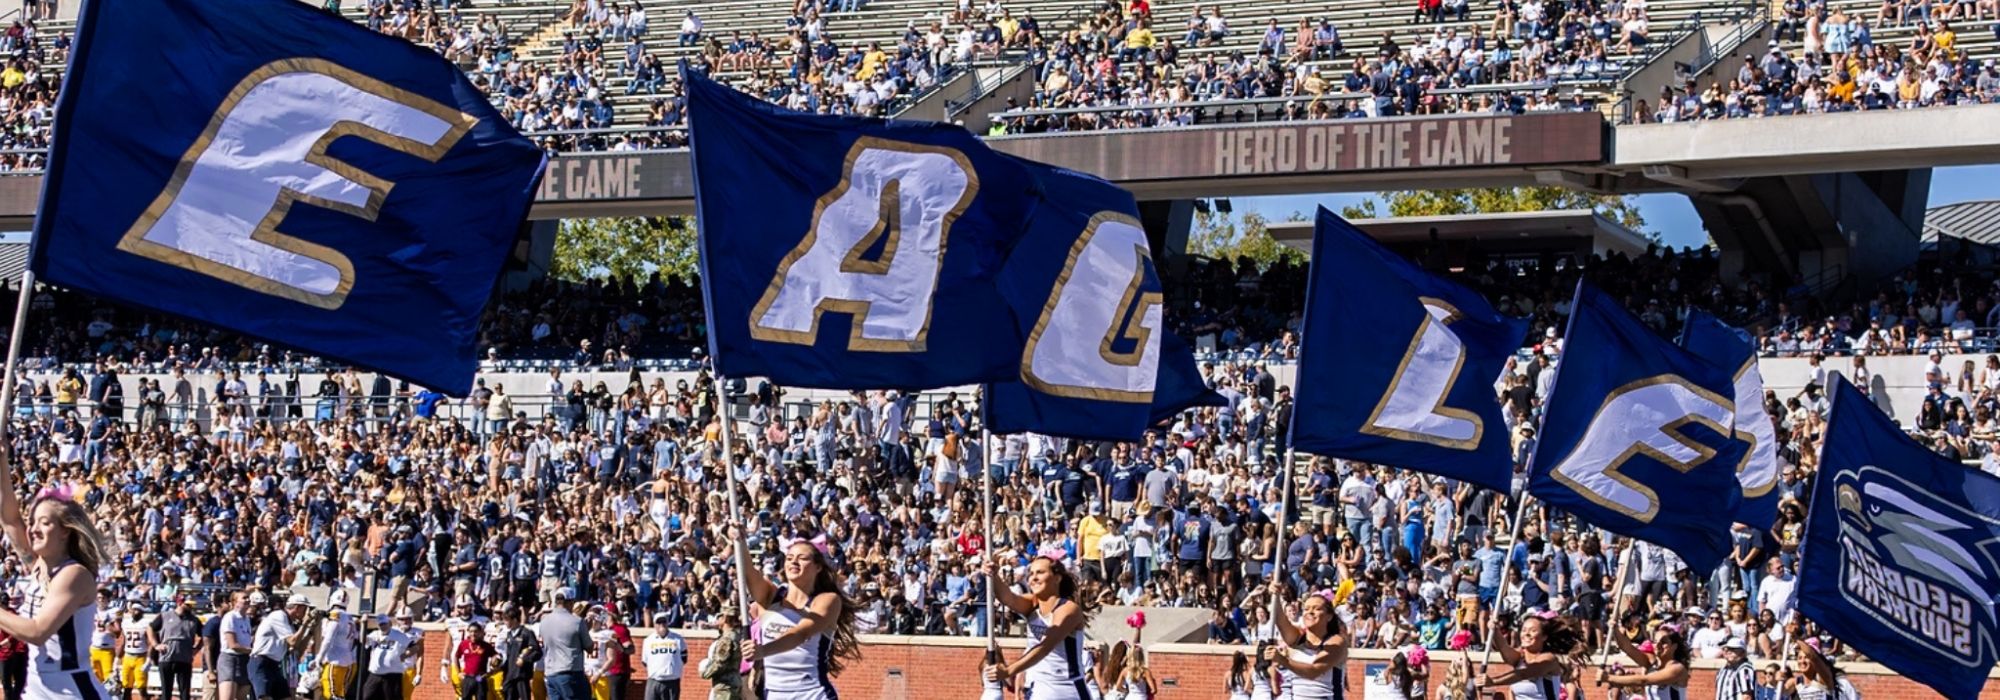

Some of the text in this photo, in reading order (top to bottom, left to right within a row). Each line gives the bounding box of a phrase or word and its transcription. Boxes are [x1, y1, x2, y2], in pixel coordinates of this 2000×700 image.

[116, 57, 480, 310] E
[565, 158, 642, 200] GAME
[1215, 117, 1512, 175] HERO OF THE GAME
[749, 135, 979, 352] A
[1020, 210, 1163, 403] G
[1358, 296, 1484, 451] L
[1550, 374, 1735, 523] E
[518, 557, 532, 576] N
[542, 555, 557, 576] E
